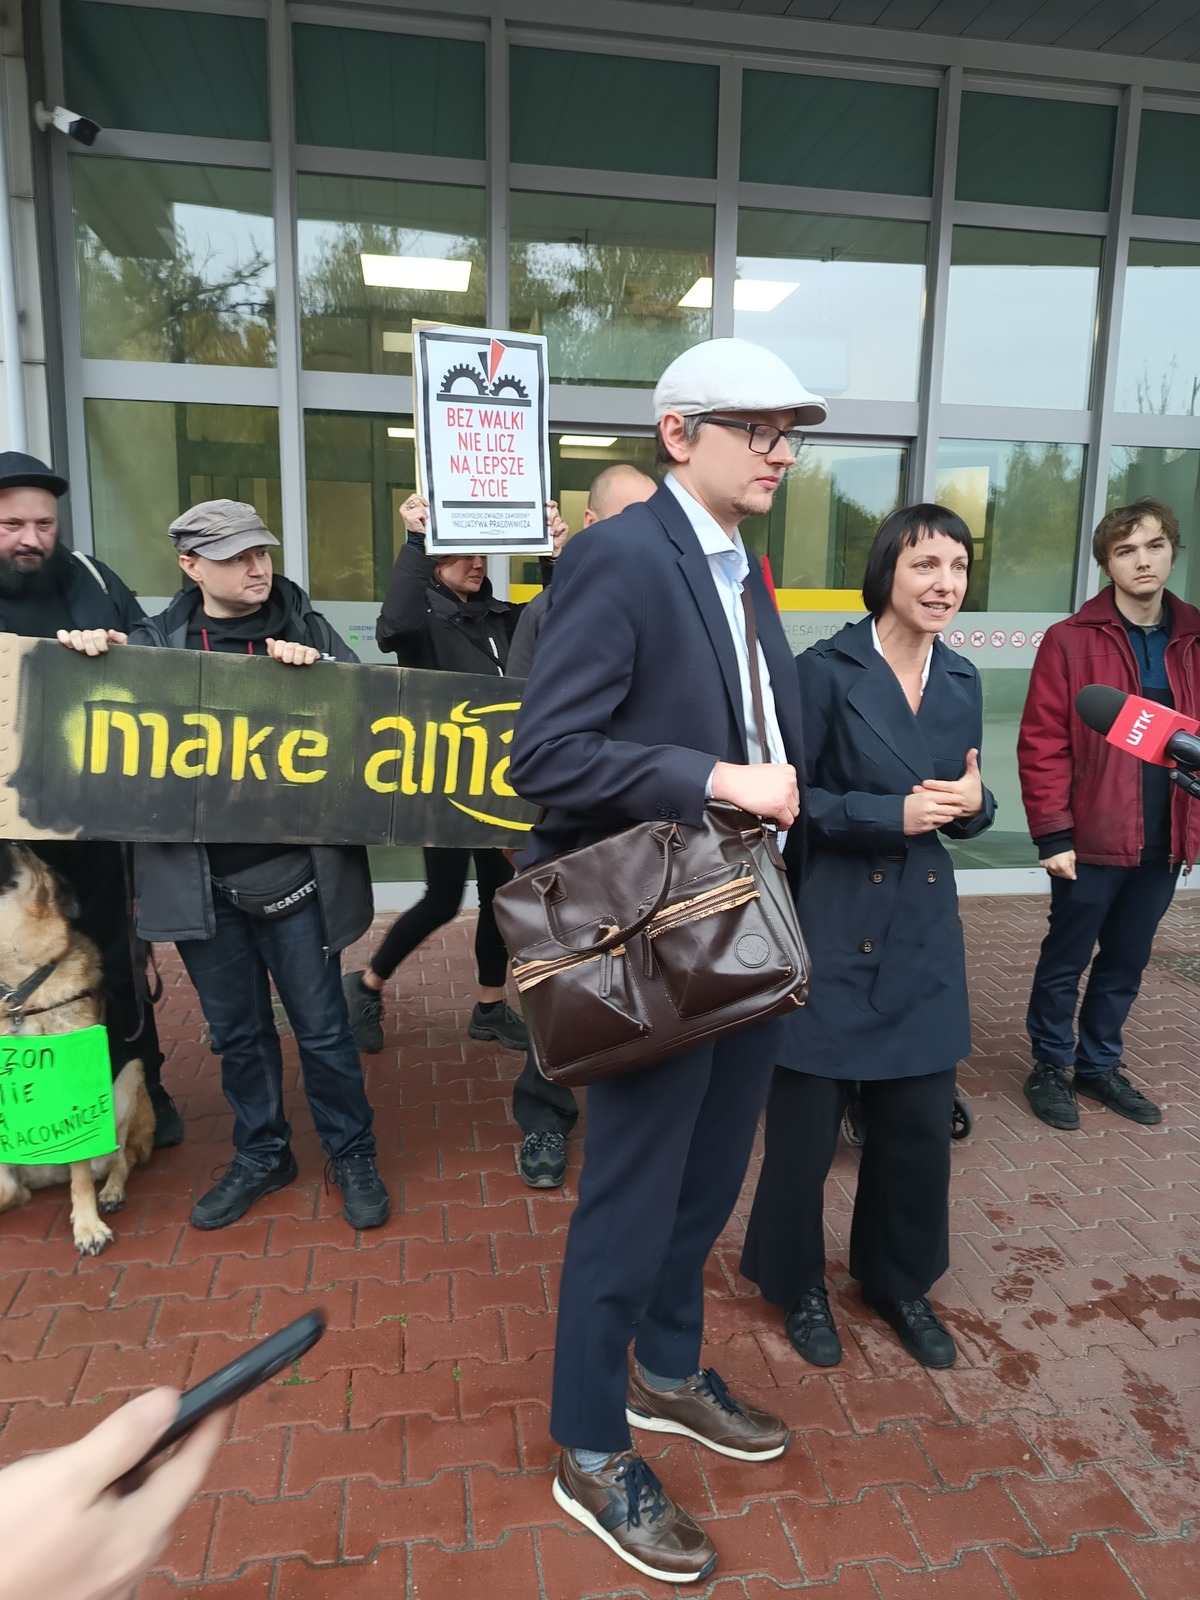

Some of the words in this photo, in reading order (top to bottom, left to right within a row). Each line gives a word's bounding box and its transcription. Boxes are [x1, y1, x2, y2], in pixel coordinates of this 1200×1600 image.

[447, 407, 473, 428] BEZ
[479, 410, 524, 430] WALKI
[458, 432, 482, 451] NIE
[487, 433, 515, 453] LICZ
[450, 455, 471, 474] NA
[475, 456, 525, 475] LEPSZE
[470, 475, 509, 498] ŻYCIE
[784, 624, 840, 636] RESANTÓ
[1125, 709, 1155, 746] WTK
[91, 709, 329, 783] make
